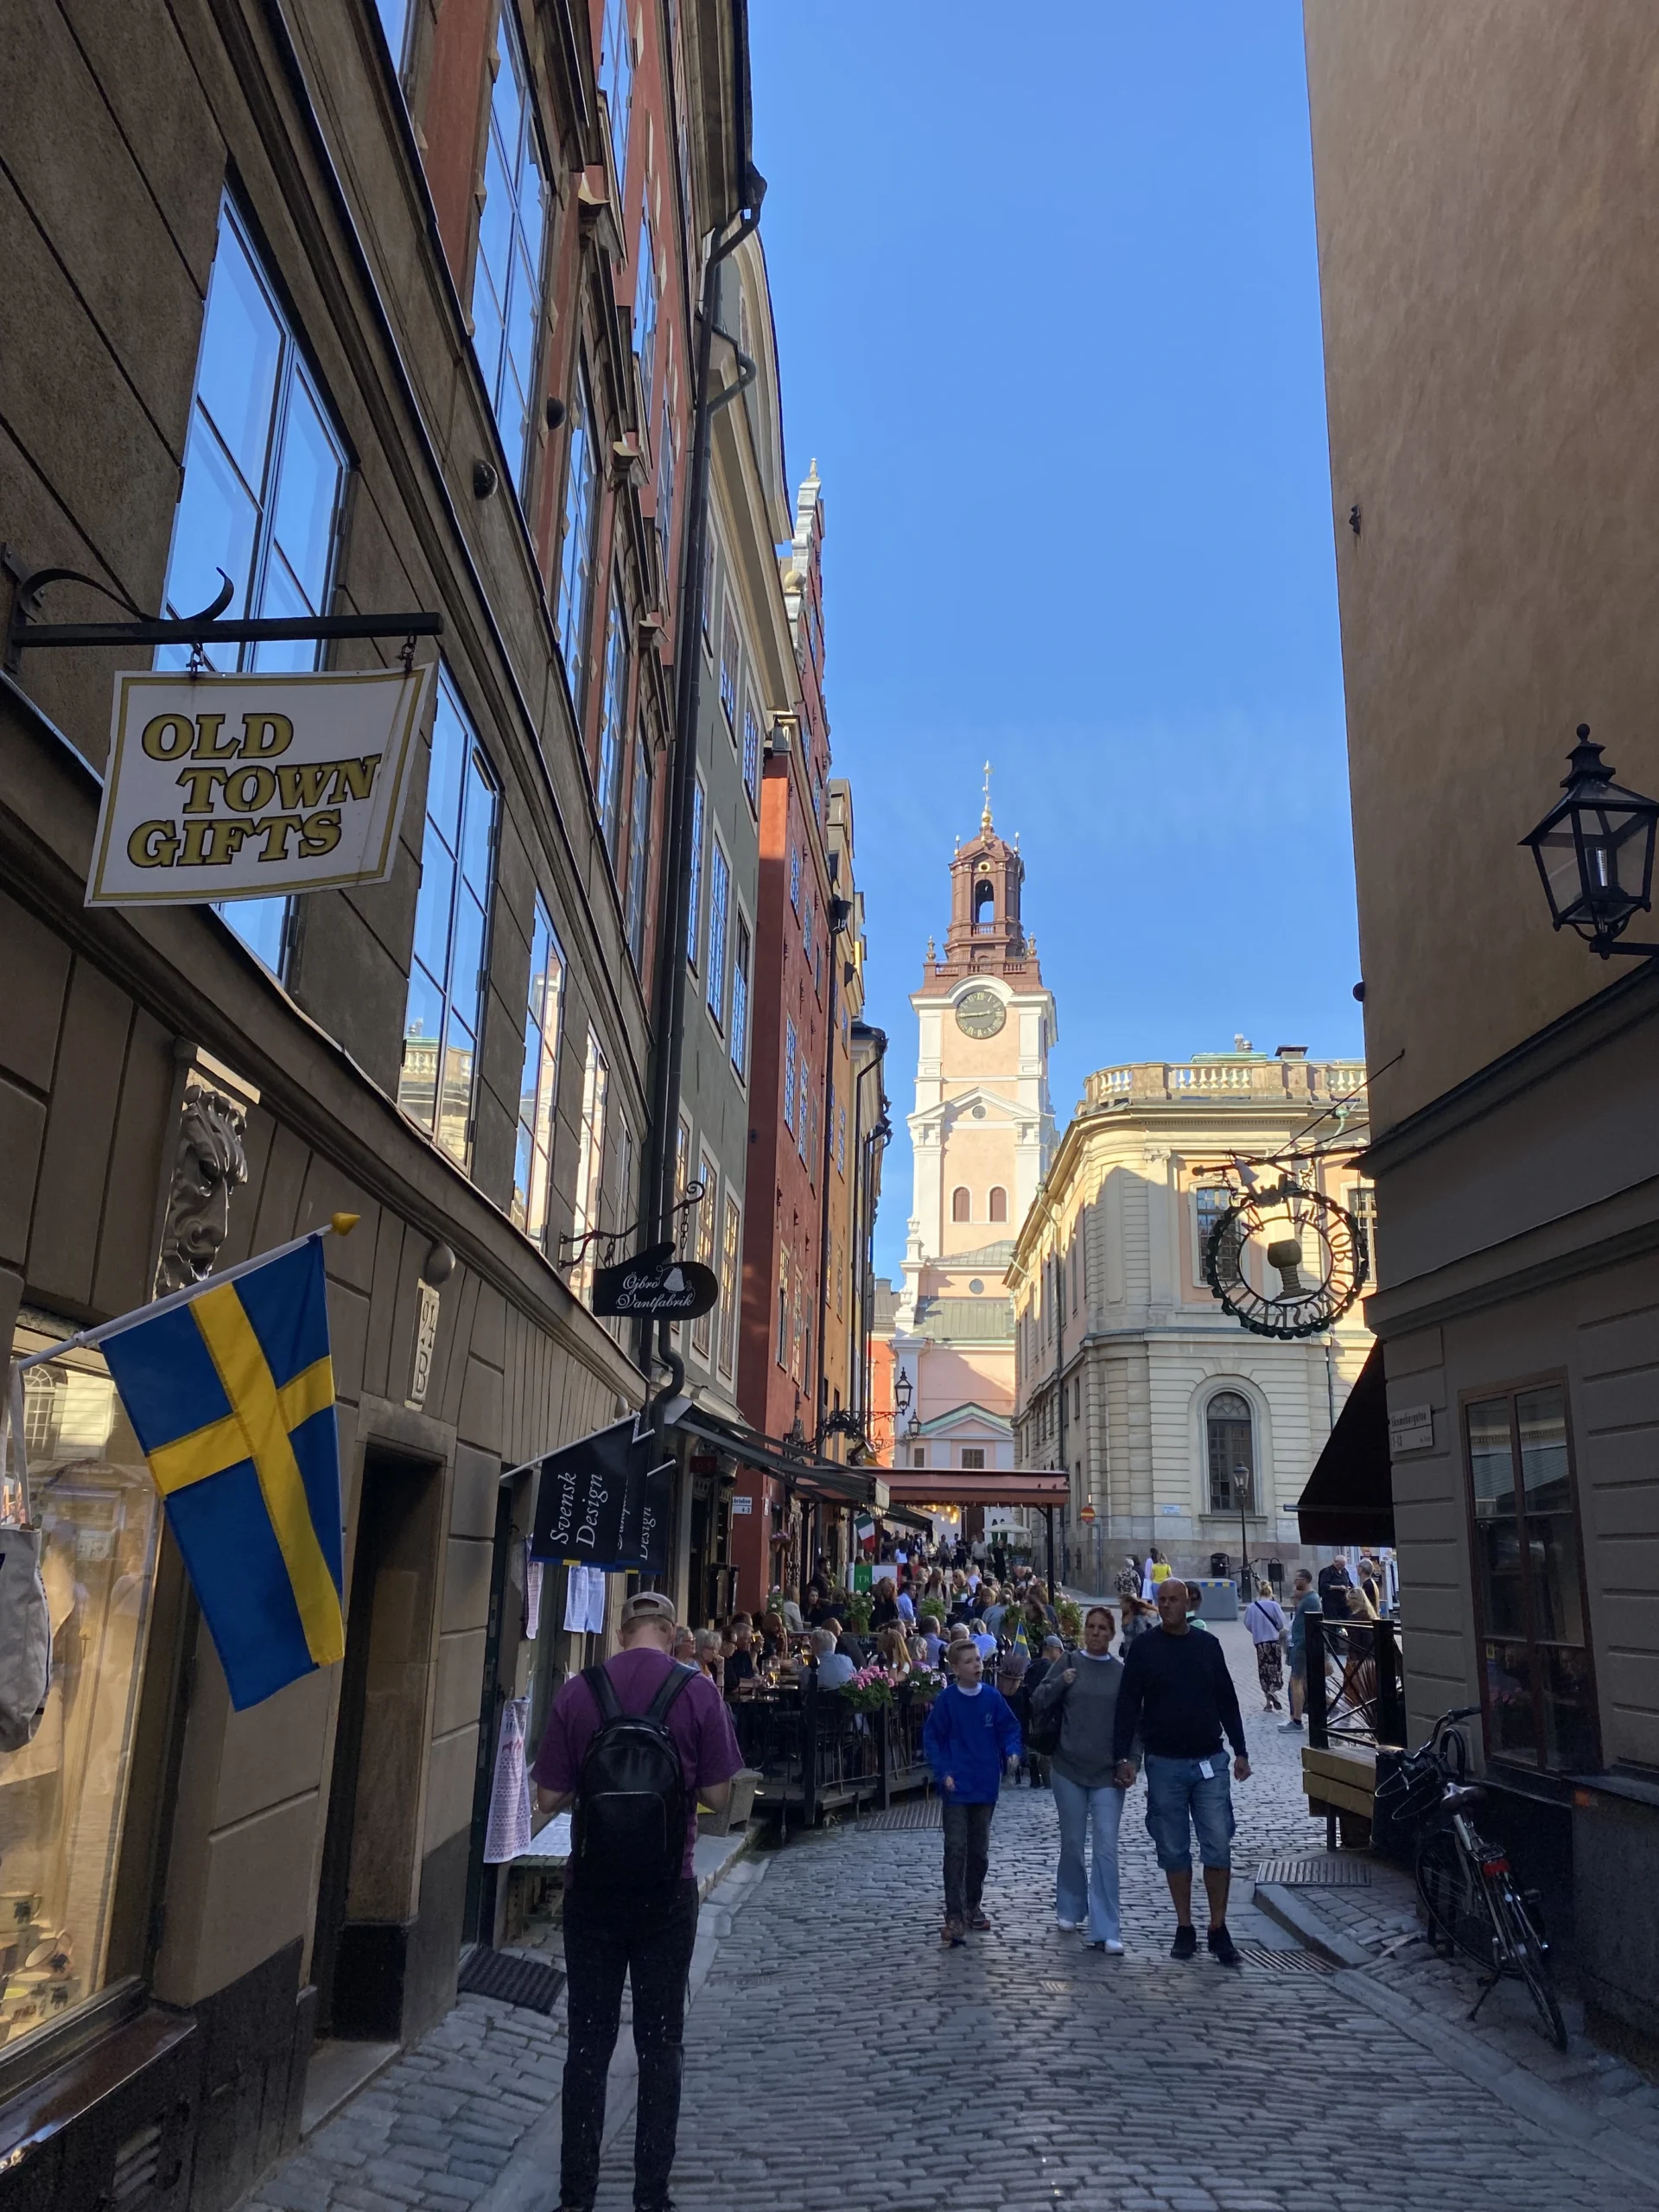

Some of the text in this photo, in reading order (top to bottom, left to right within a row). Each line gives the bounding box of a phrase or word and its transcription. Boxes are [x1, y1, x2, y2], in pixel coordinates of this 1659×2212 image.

[142, 713, 294, 760] OLD
[176, 753, 382, 814] TOWN
[127, 810, 342, 868] GIFTS
[616, 1293, 693, 1313] Vantfabrik
[623, 1271, 659, 1295] Öjbro
[550, 1472, 577, 1545] Svensk
[576, 1474, 608, 1548] Design
